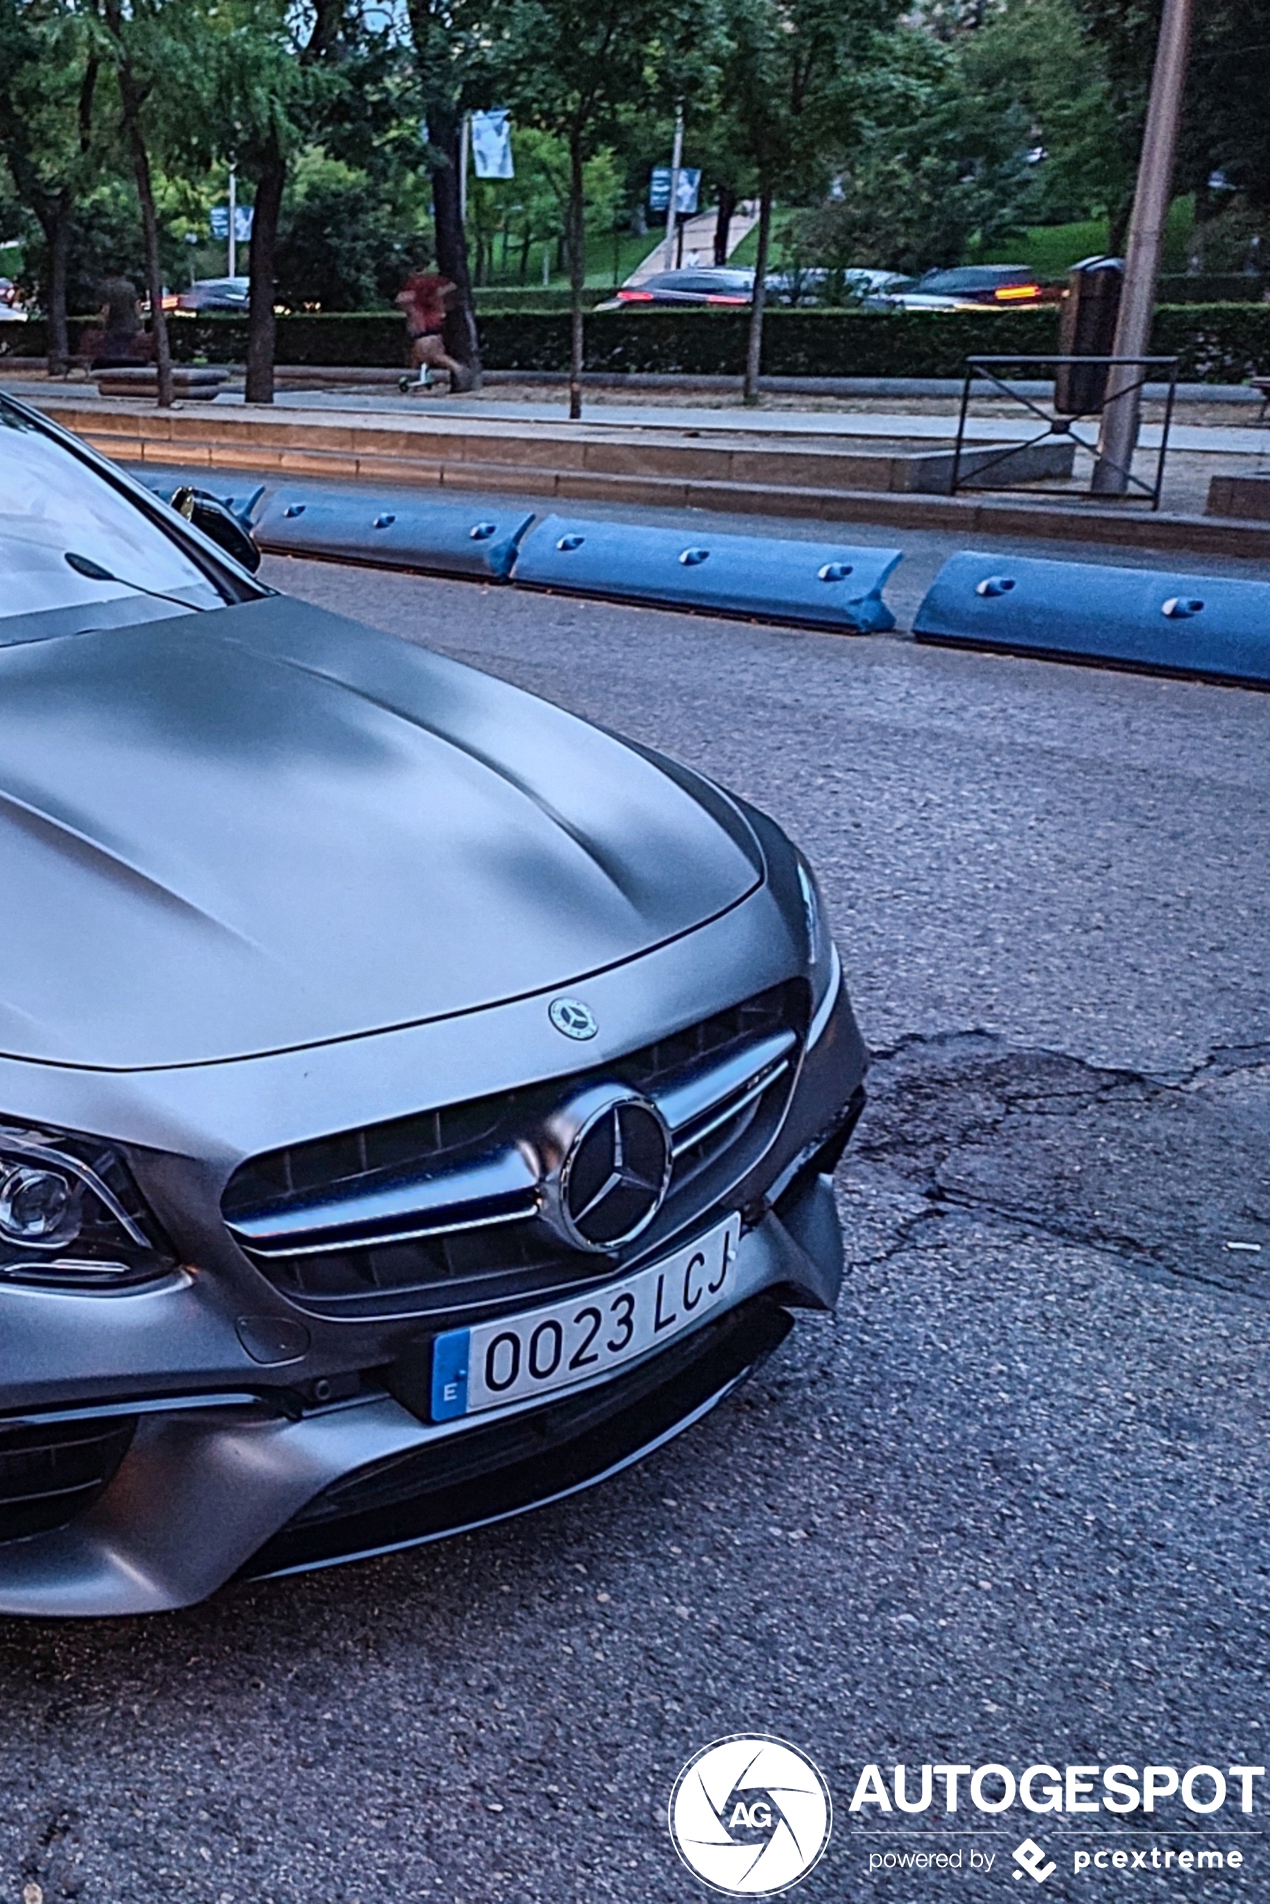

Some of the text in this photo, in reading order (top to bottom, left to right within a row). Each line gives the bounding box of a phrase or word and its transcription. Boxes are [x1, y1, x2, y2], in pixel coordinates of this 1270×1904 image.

[484, 1231, 731, 1392] 0023 LCJ
[443, 1382, 459, 1402] E
